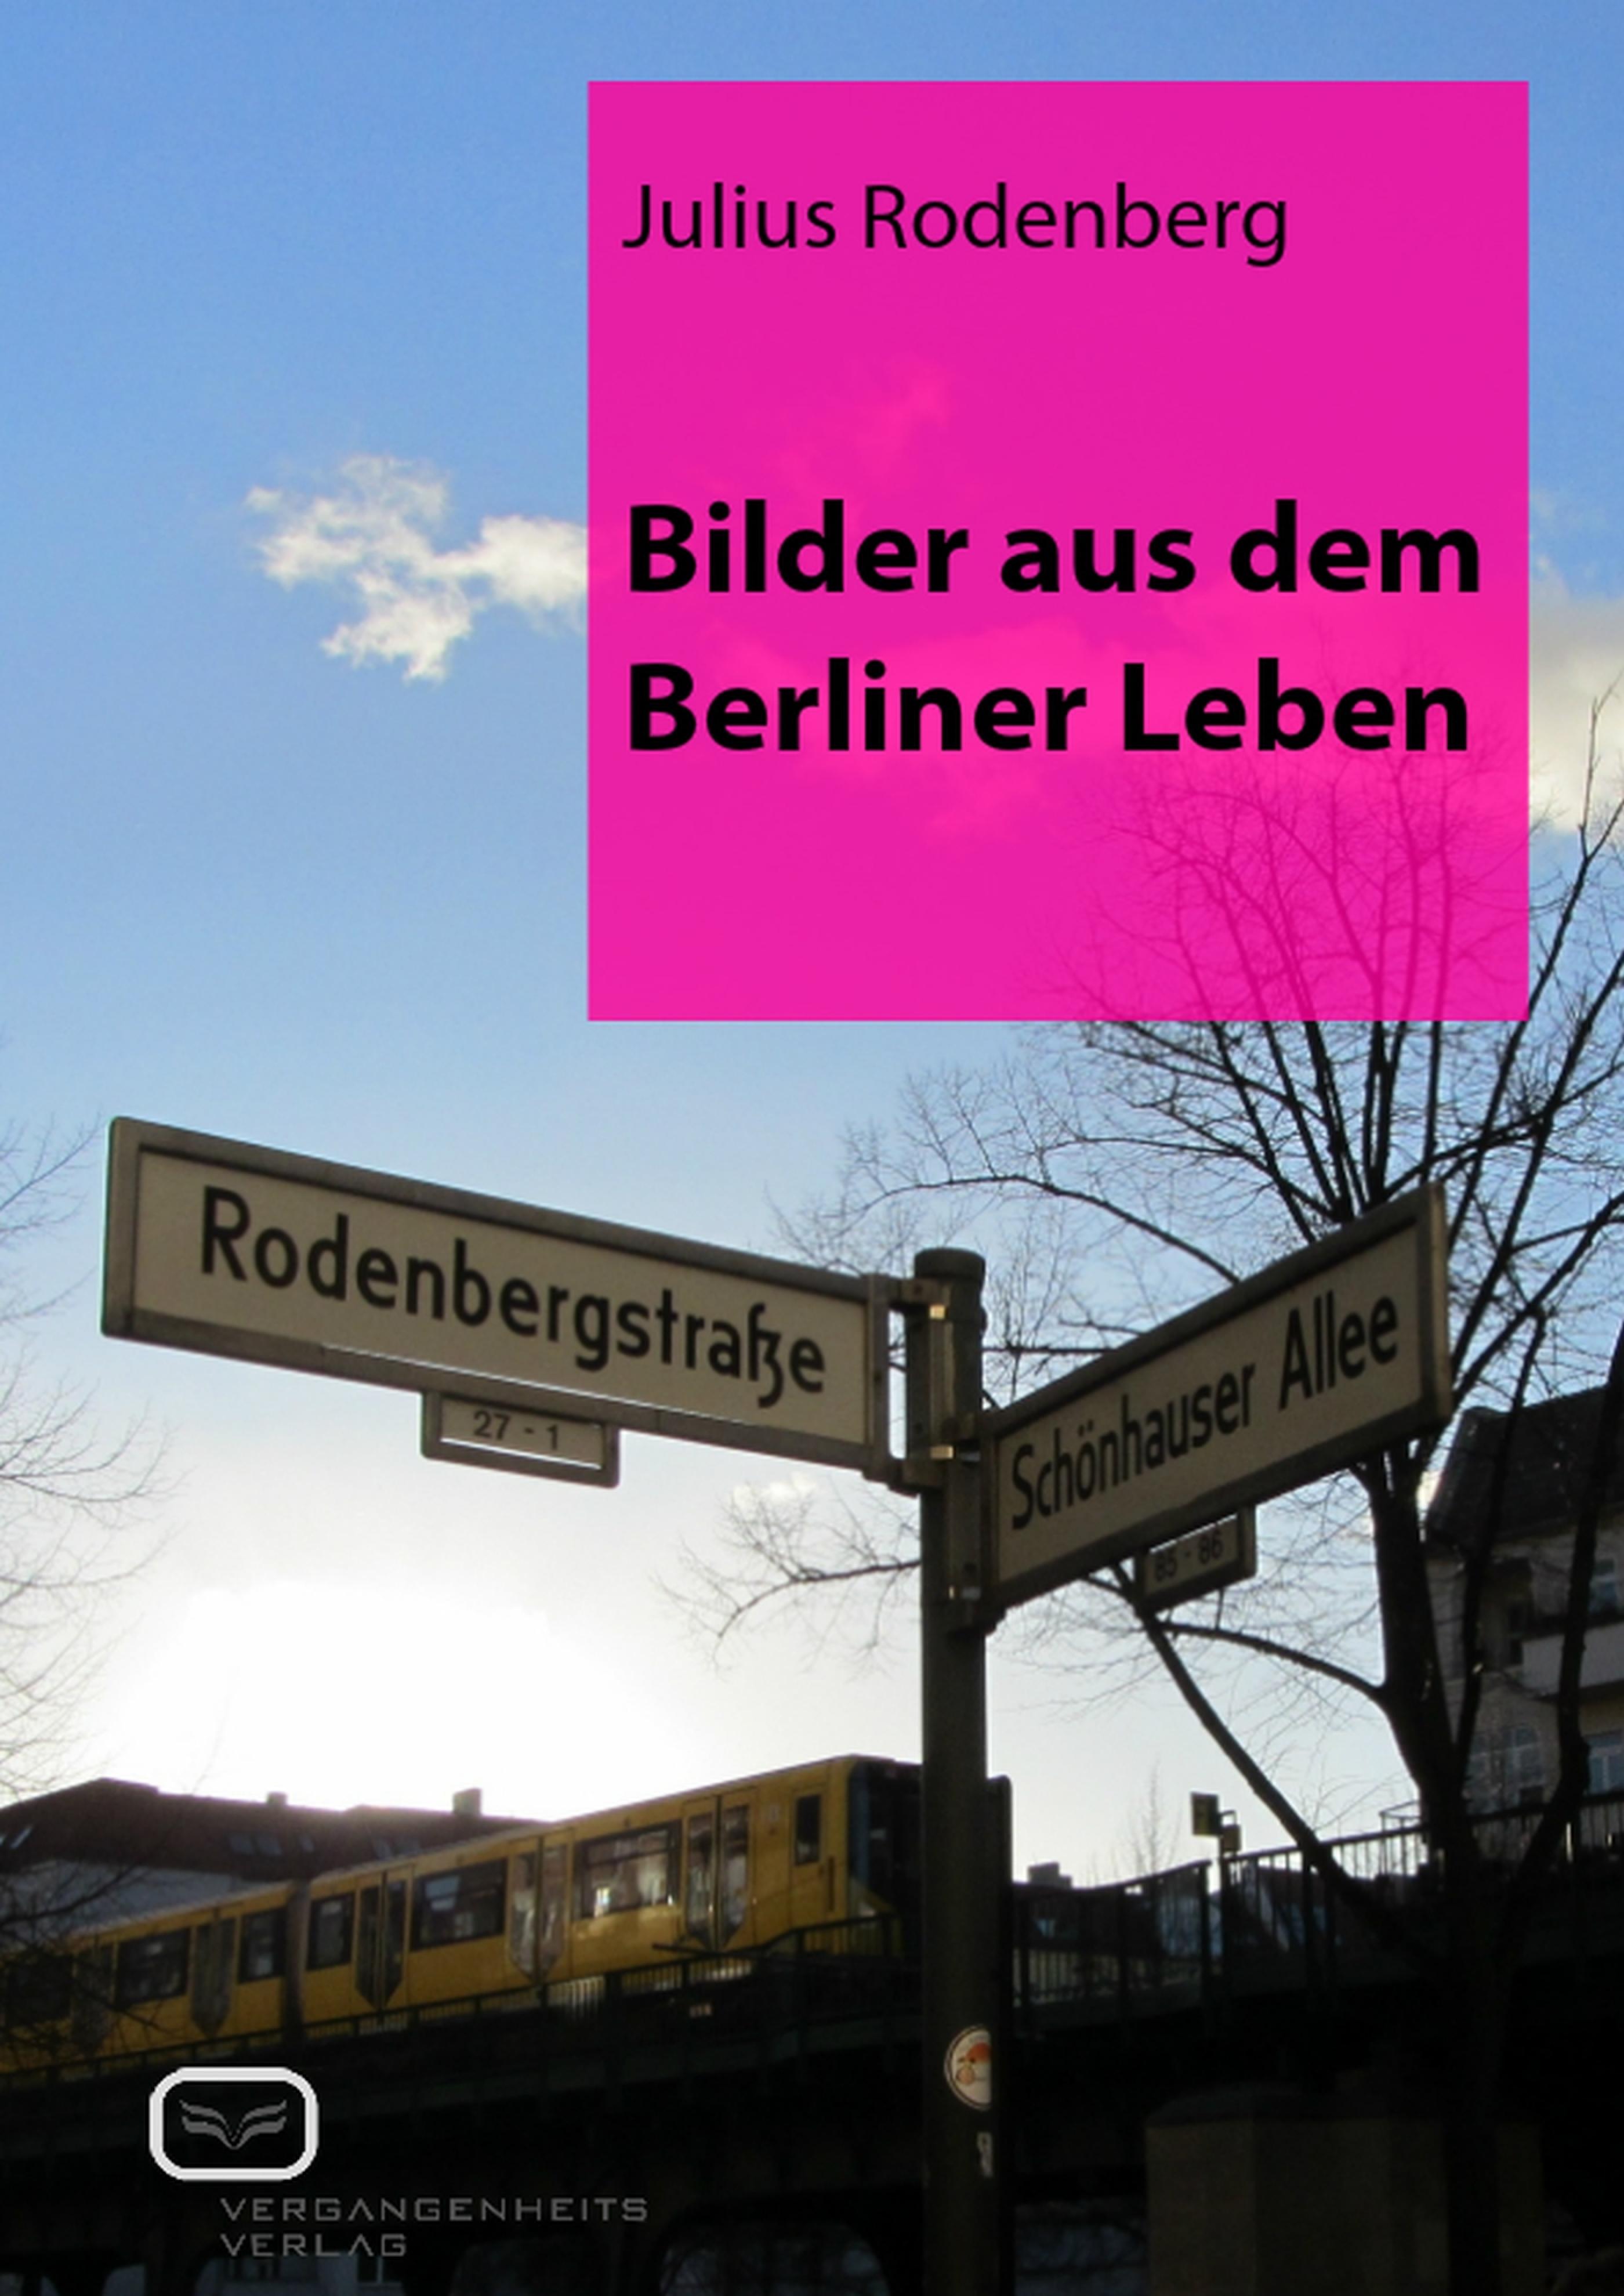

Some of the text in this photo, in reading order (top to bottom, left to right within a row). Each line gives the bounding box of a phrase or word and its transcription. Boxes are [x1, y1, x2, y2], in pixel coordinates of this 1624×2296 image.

[201, 1185, 826, 1408] Rodenbergstraße
[473, 1410, 510, 1440] 27
[546, 1424, 558, 1450] 1
[1012, 1289, 1400, 1530] Schönhauser Allee
